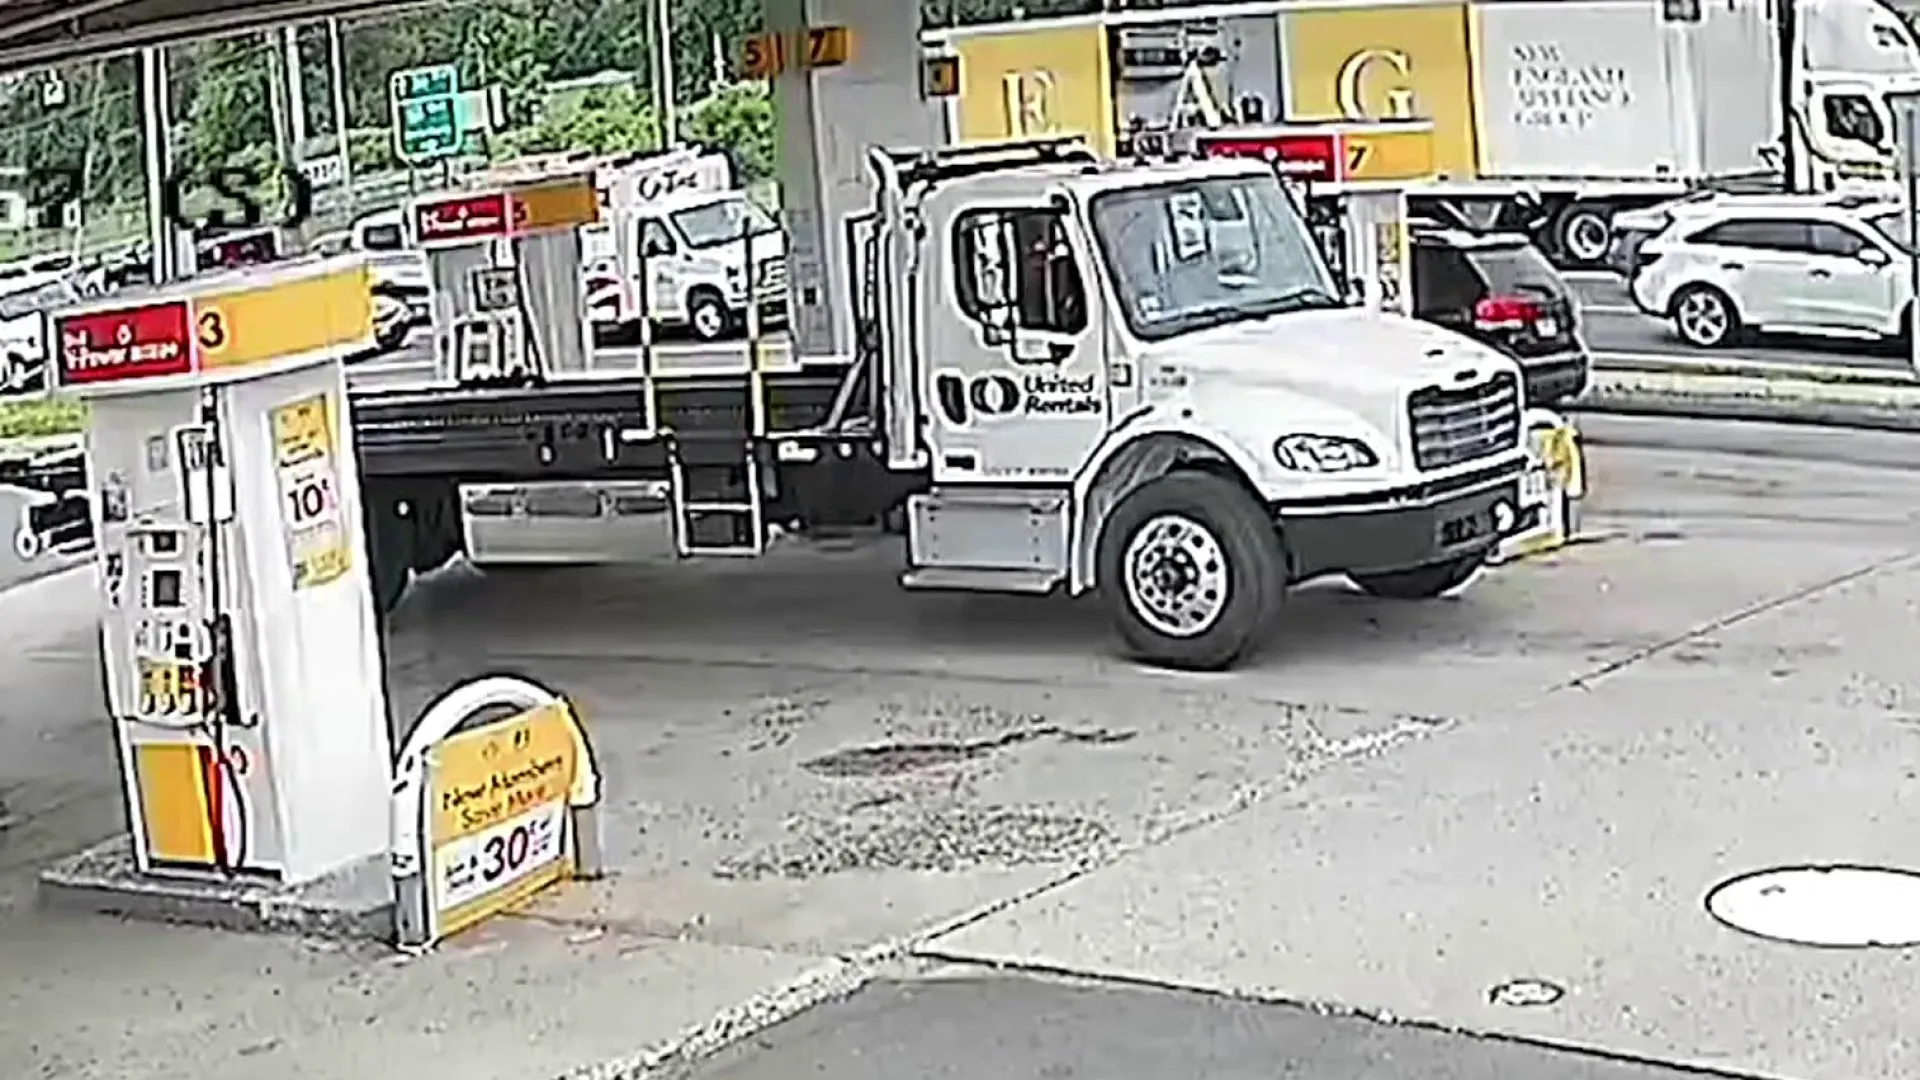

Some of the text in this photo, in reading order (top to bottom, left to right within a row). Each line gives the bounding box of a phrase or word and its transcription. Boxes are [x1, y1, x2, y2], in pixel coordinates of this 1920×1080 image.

[809, 29, 827, 61] 7
[1001, 66, 1057, 137] E
[1166, 56, 1224, 132] A
[1335, 46, 1413, 120] G
[1348, 146, 1367, 171] 7
[199, 311, 224, 348] 3
[1023, 373, 1095, 394] United
[1023, 394, 1103, 415] Rentals
